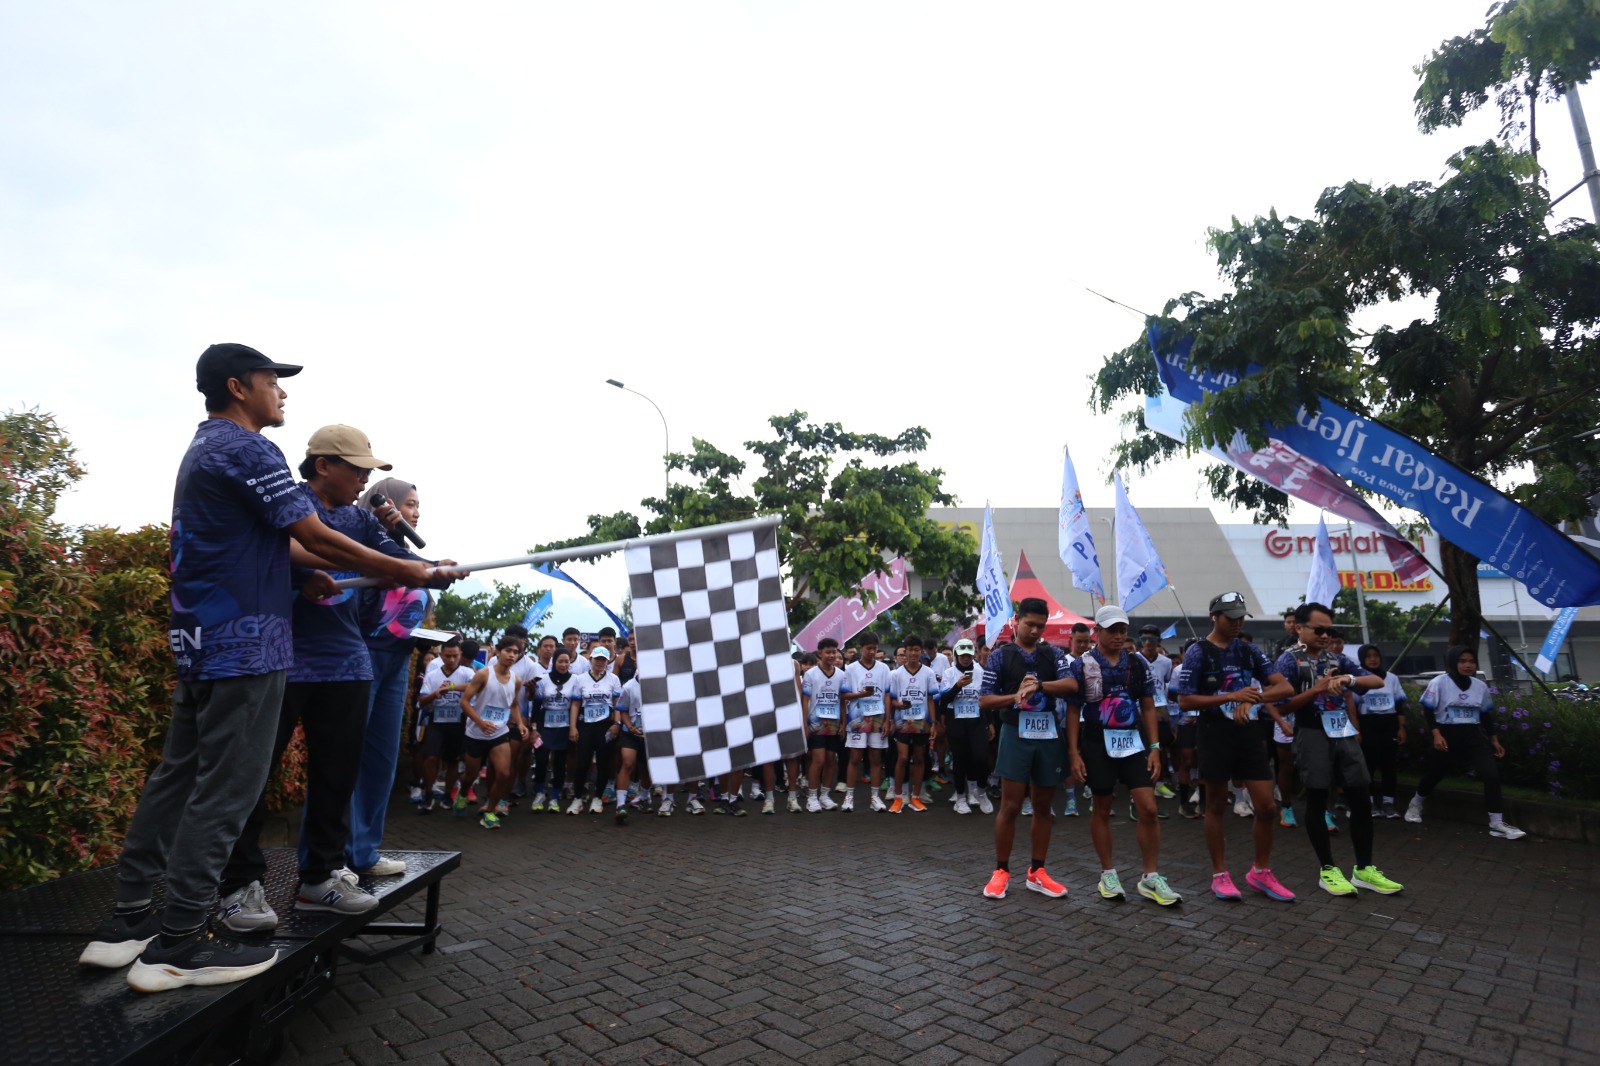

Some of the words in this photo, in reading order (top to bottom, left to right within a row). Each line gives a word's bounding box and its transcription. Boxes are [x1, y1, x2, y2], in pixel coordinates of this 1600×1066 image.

[1296, 403, 1368, 463] Ijen
[1351, 467, 1376, 485] Pos
[1371, 443, 1484, 529] Radar
[1378, 479, 1415, 501] Jawa
[1297, 529, 1425, 554] matahi
[900, 690, 926, 698] IJEN
[1025, 718, 1049, 731] PACER
[1111, 737, 1135, 748] PACER
